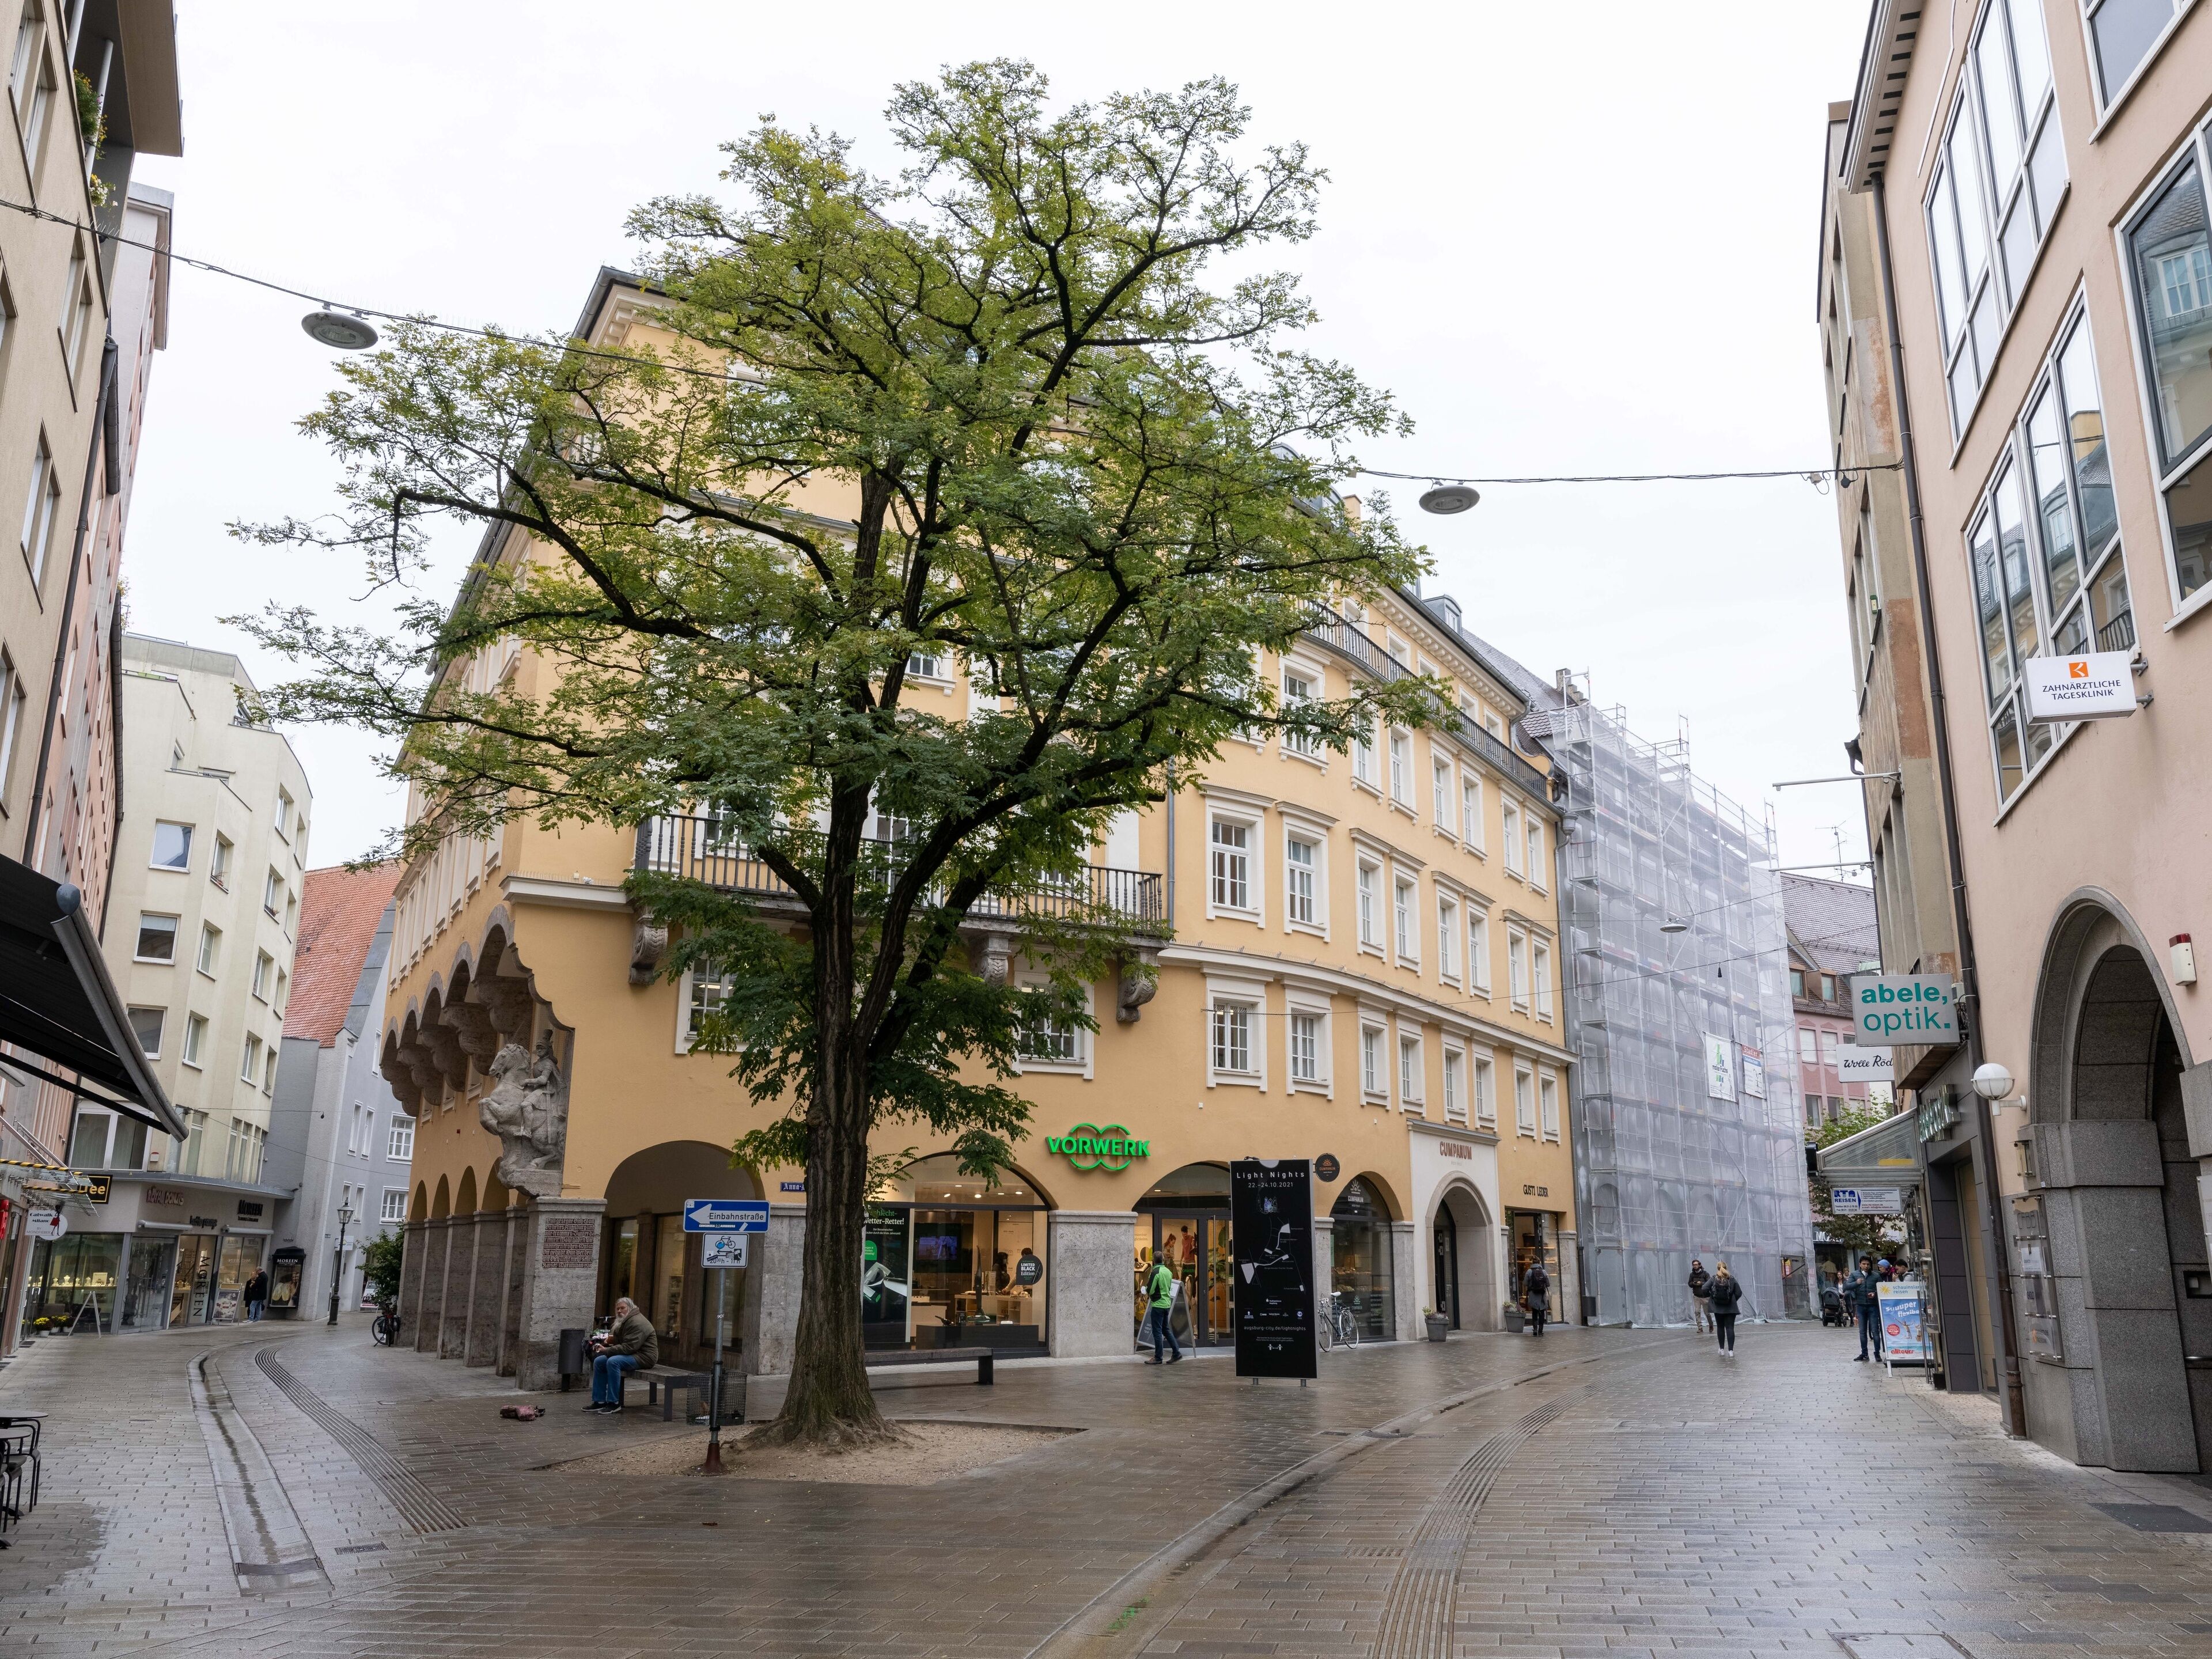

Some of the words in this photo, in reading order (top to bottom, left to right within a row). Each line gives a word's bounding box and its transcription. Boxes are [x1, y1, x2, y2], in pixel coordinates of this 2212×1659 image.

[2042, 680, 2121, 692] ZAHNÄRZTLICHE
[2051, 689, 2114, 700] TAGESKLINIK
[1861, 983, 1948, 1005] abele,
[1863, 1007, 1950, 1036] optik.
[1844, 1059, 1869, 1068] Wolle
[1046, 1136, 1151, 1157] VORWERK
[1440, 1141, 1472, 1160] CUMPANUM
[1236, 1172, 1263, 1180] Light
[1523, 1184, 1536, 1196] GUSTI
[1537, 1186, 1549, 1198] LEDER
[192, 1255, 211, 1317] MOREEN
[1897, 1309, 1920, 1317] flexibe
